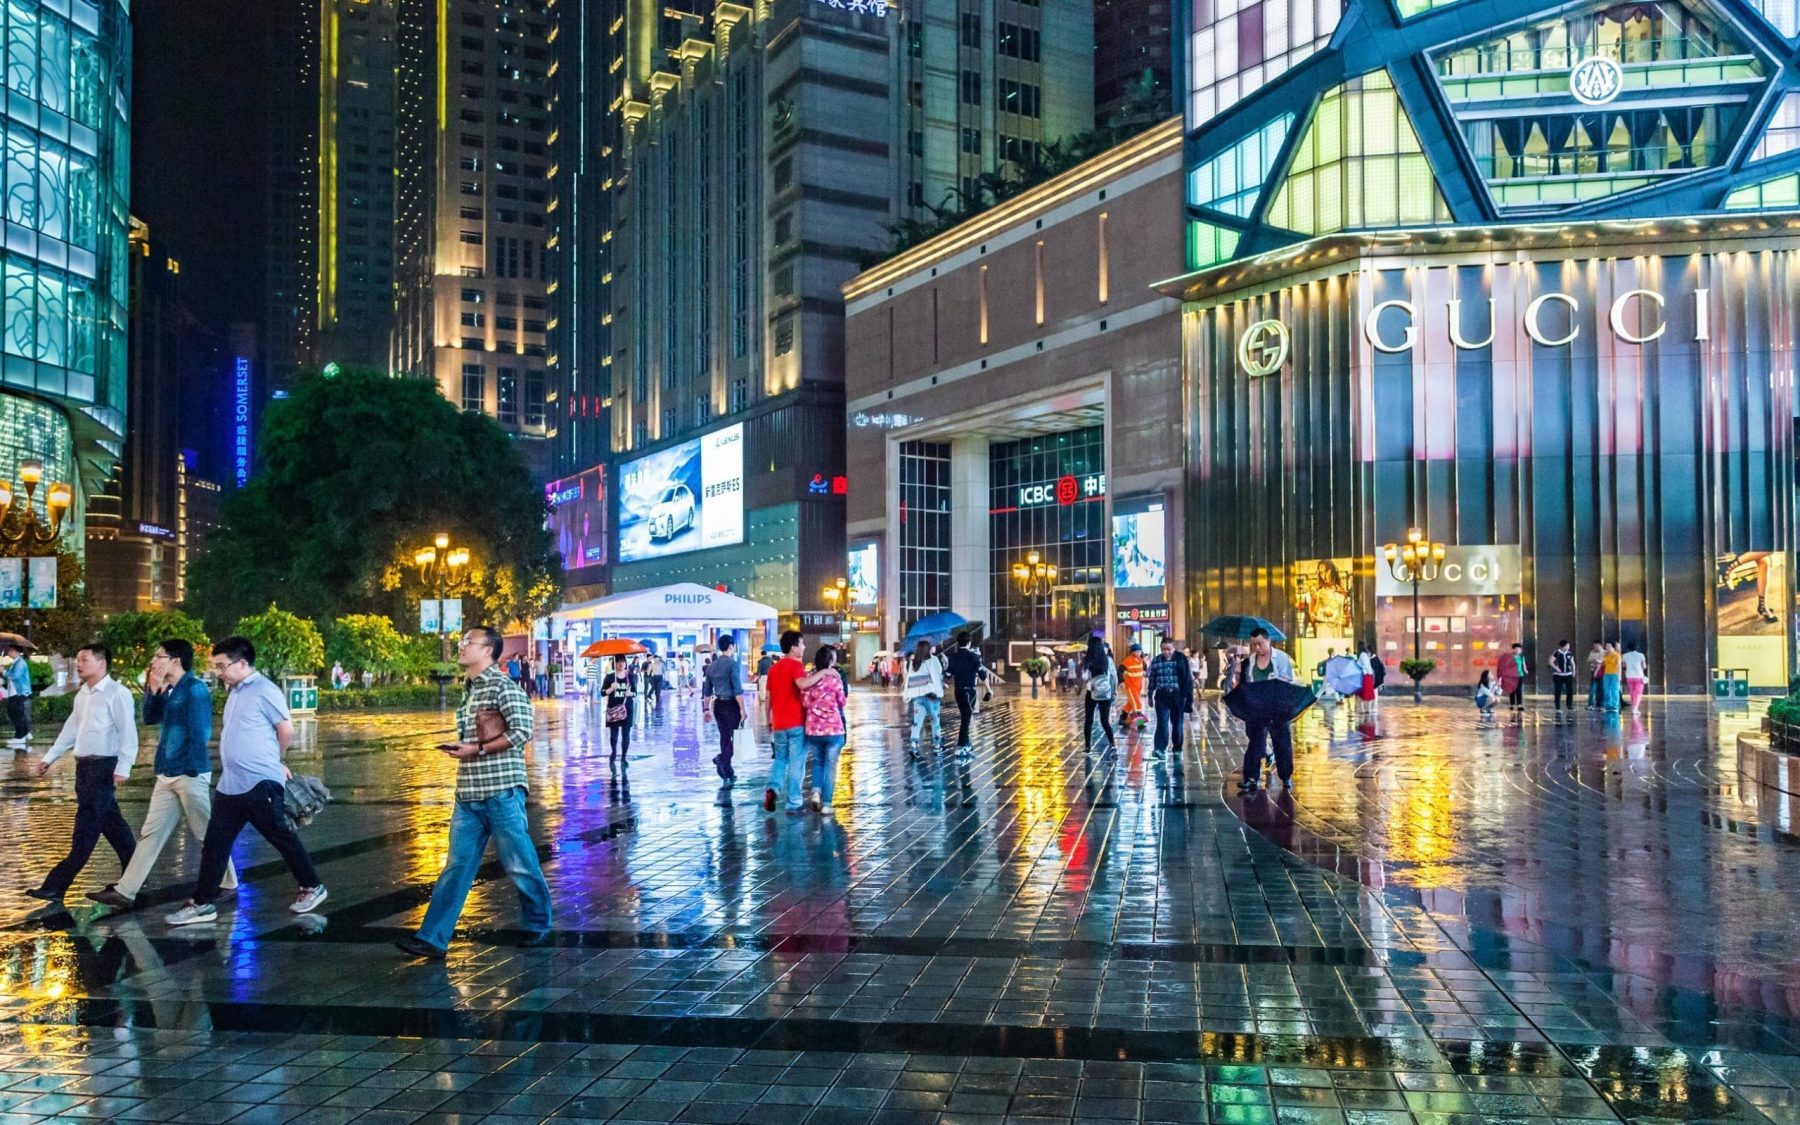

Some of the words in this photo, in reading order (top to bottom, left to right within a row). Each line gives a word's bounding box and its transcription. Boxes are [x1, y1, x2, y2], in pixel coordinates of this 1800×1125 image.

[1365, 289, 1709, 353] GUCCI
[236, 357, 248, 422] SOMERSET
[1020, 484, 1054, 505] ICBC
[1397, 563, 1499, 581] GUCCI
[664, 593, 712, 604] PHILIPS
